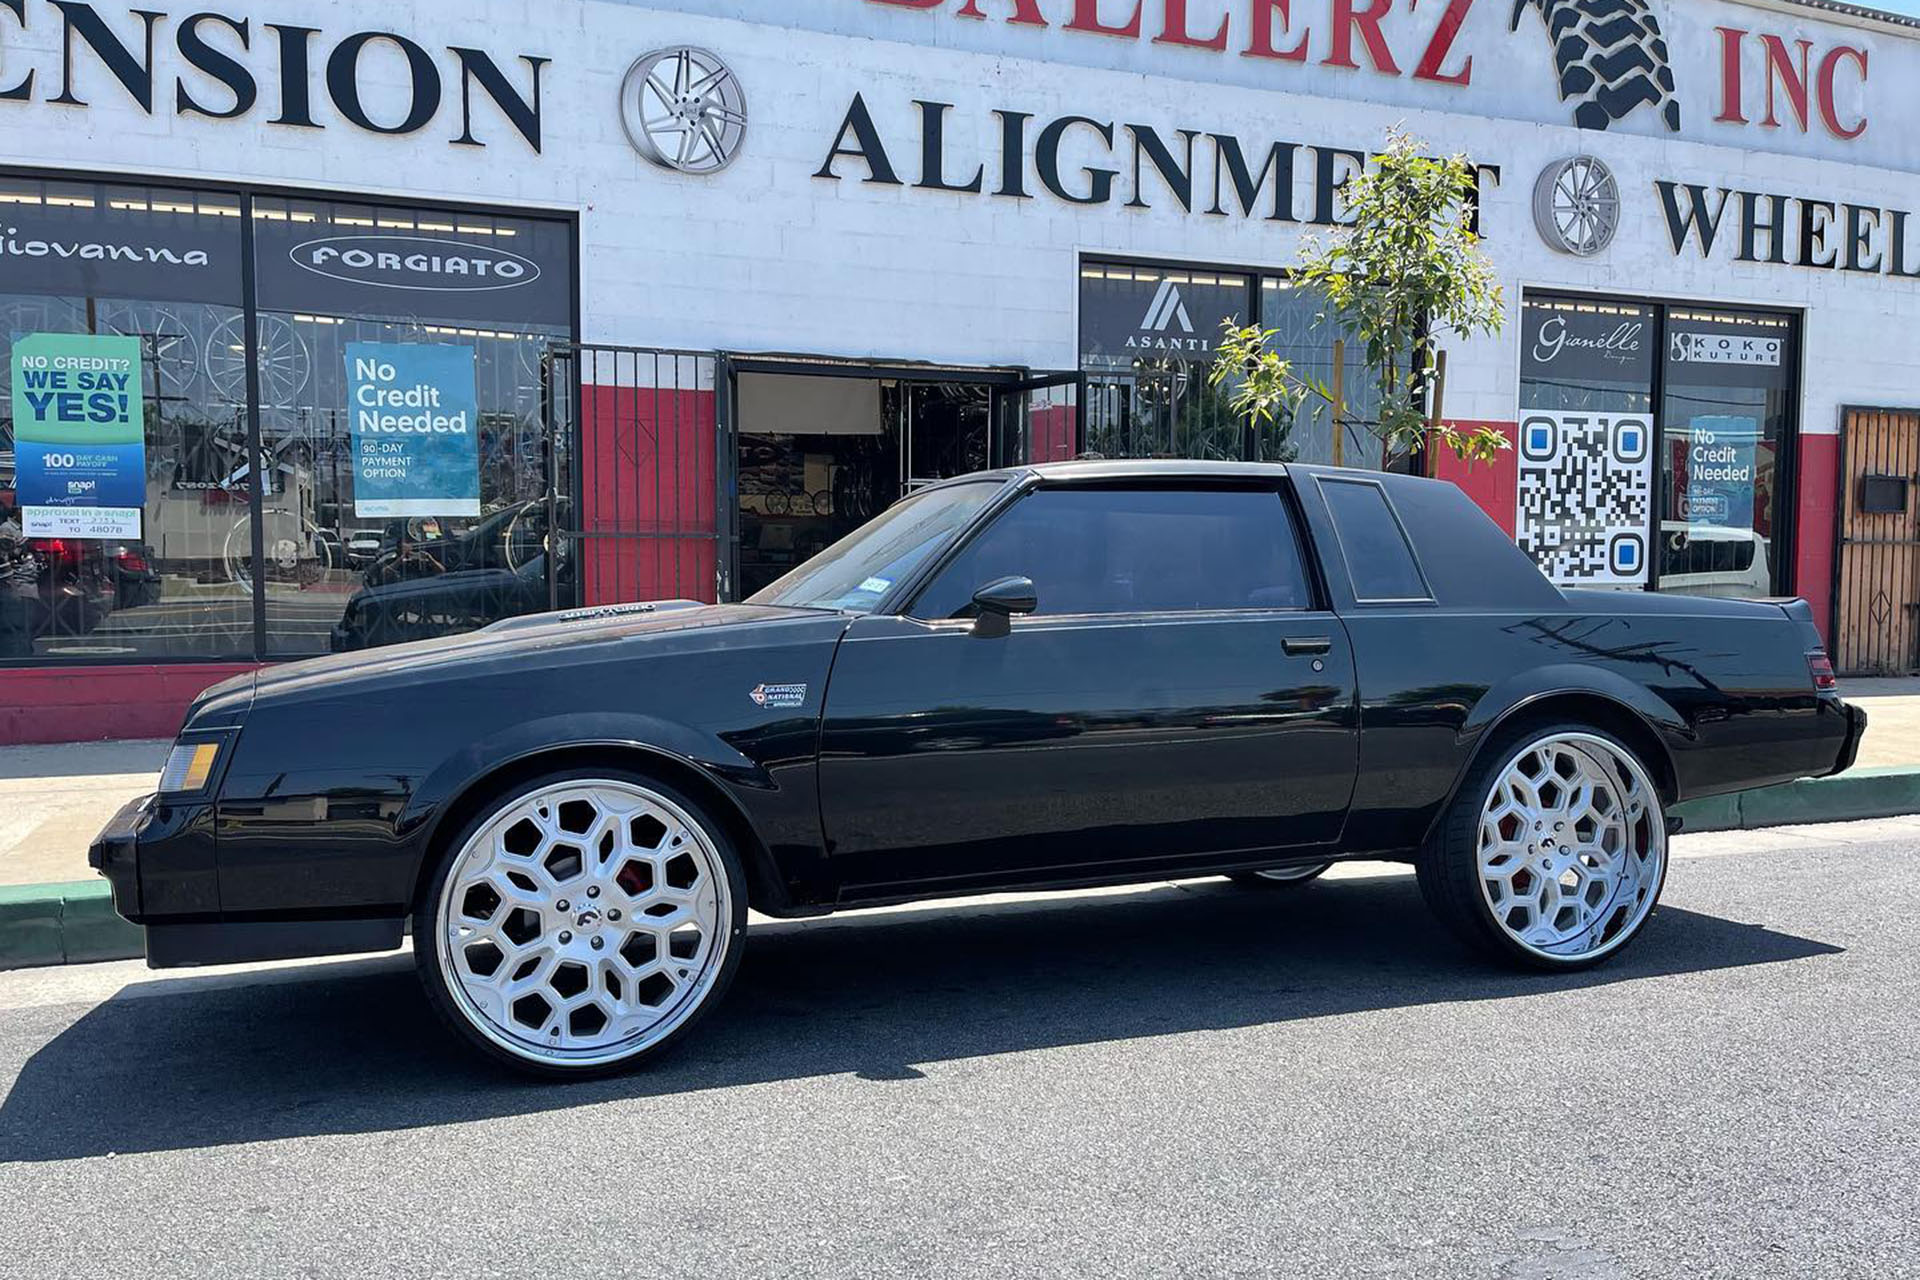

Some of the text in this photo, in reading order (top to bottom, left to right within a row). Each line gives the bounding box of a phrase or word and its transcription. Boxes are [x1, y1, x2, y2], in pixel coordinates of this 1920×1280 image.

[1714, 26, 1869, 140] INC
[0, 225, 208, 266] iovanna
[311, 246, 525, 279] FORGIATO
[1125, 334, 1210, 352] ASANTI
[1695, 337, 1779, 352] KOKO
[22, 355, 130, 371] NO CREDIT?
[1694, 351, 1778, 363] KUTURE
[356, 358, 396, 381] No
[23, 370, 130, 391] WE SAY
[356, 384, 441, 408] Credit
[24, 391, 129, 423] YES!
[359, 410, 467, 433] Needed
[1694, 428, 1715, 444] No
[42, 453, 75, 468] 100
[361, 456, 412, 466] PAYMENT
[1693, 446, 1737, 462] Credit
[363, 468, 406, 478] OPTION
[1693, 464, 1749, 481] Needed
